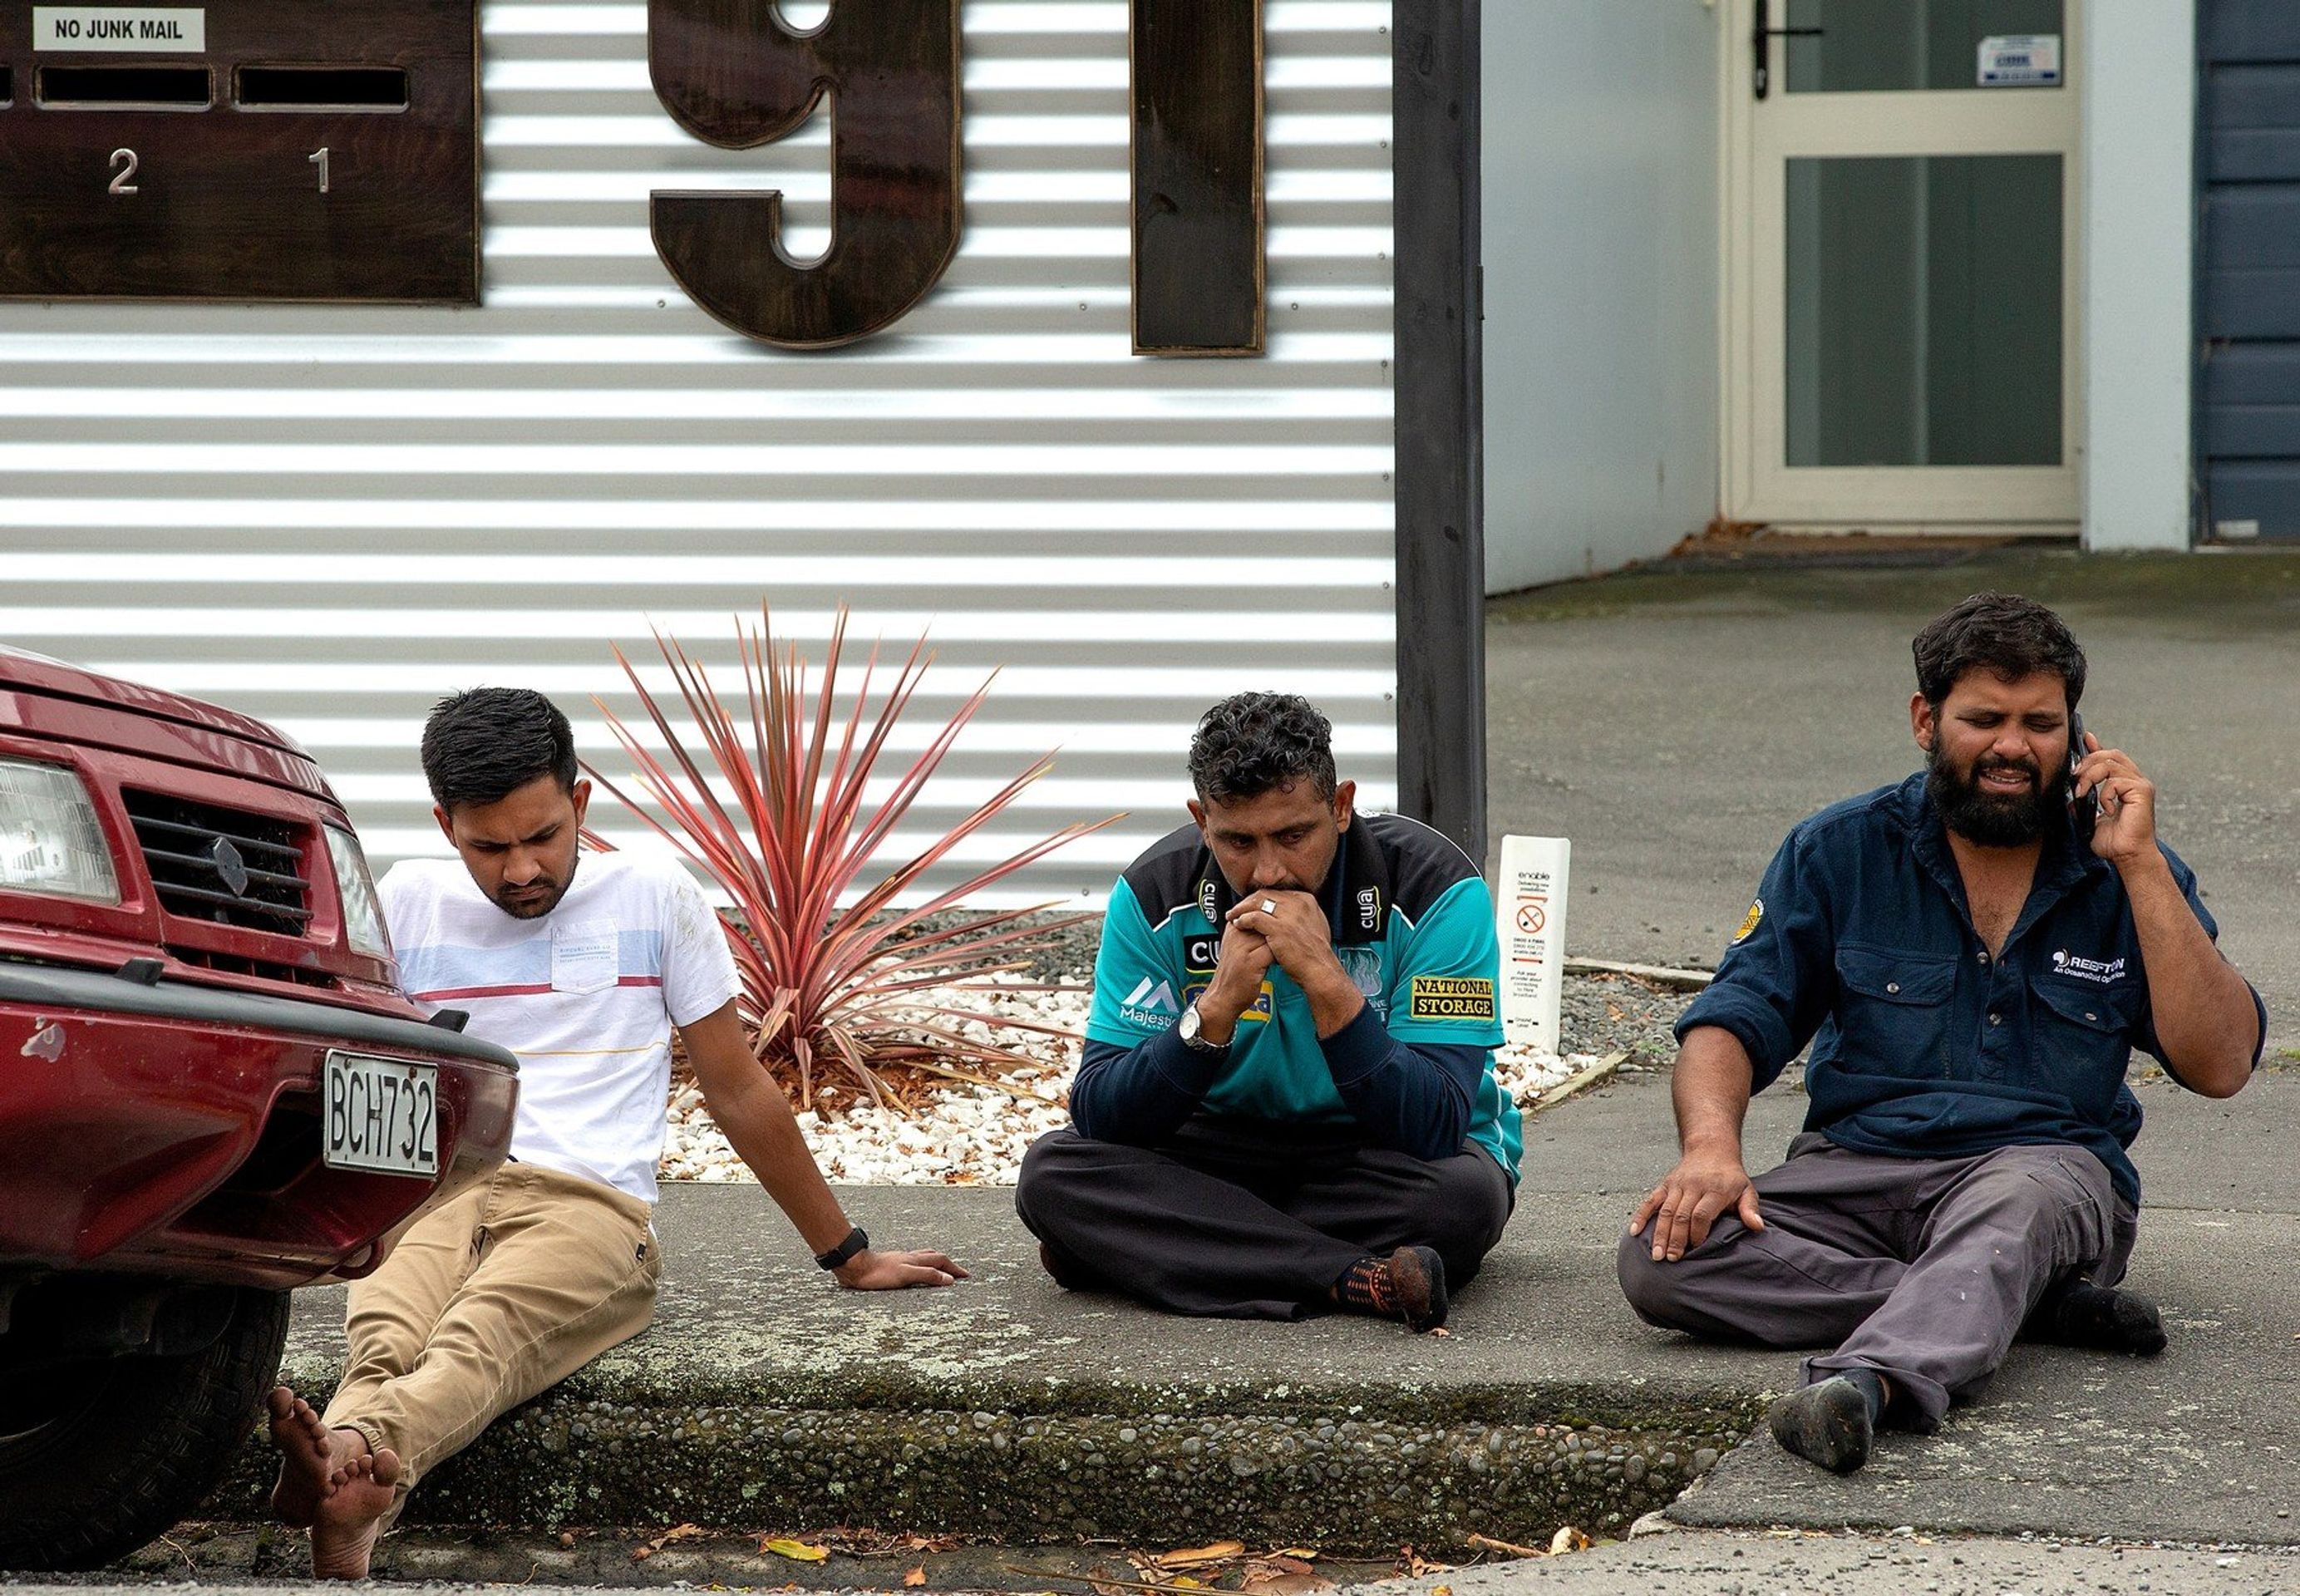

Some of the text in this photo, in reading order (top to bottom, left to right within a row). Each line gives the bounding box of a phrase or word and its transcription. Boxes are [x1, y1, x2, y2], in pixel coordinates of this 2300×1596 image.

[56, 19, 183, 39] NO JUNK MAIL
[108, 147, 139, 195] 2
[308, 146, 329, 194] 1
[1518, 872, 1550, 880] enable
[1202, 883, 1218, 924] cua
[1357, 888, 1377, 929] cua
[2053, 965, 2064, 973] An
[2070, 957, 2125, 974] REEFTON
[1415, 979, 1493, 996] NATIONAL
[1119, 1005, 1177, 1028] Majesti
[1418, 998, 1491, 1015] STORAGE
[331, 1066, 434, 1162] BCH732
